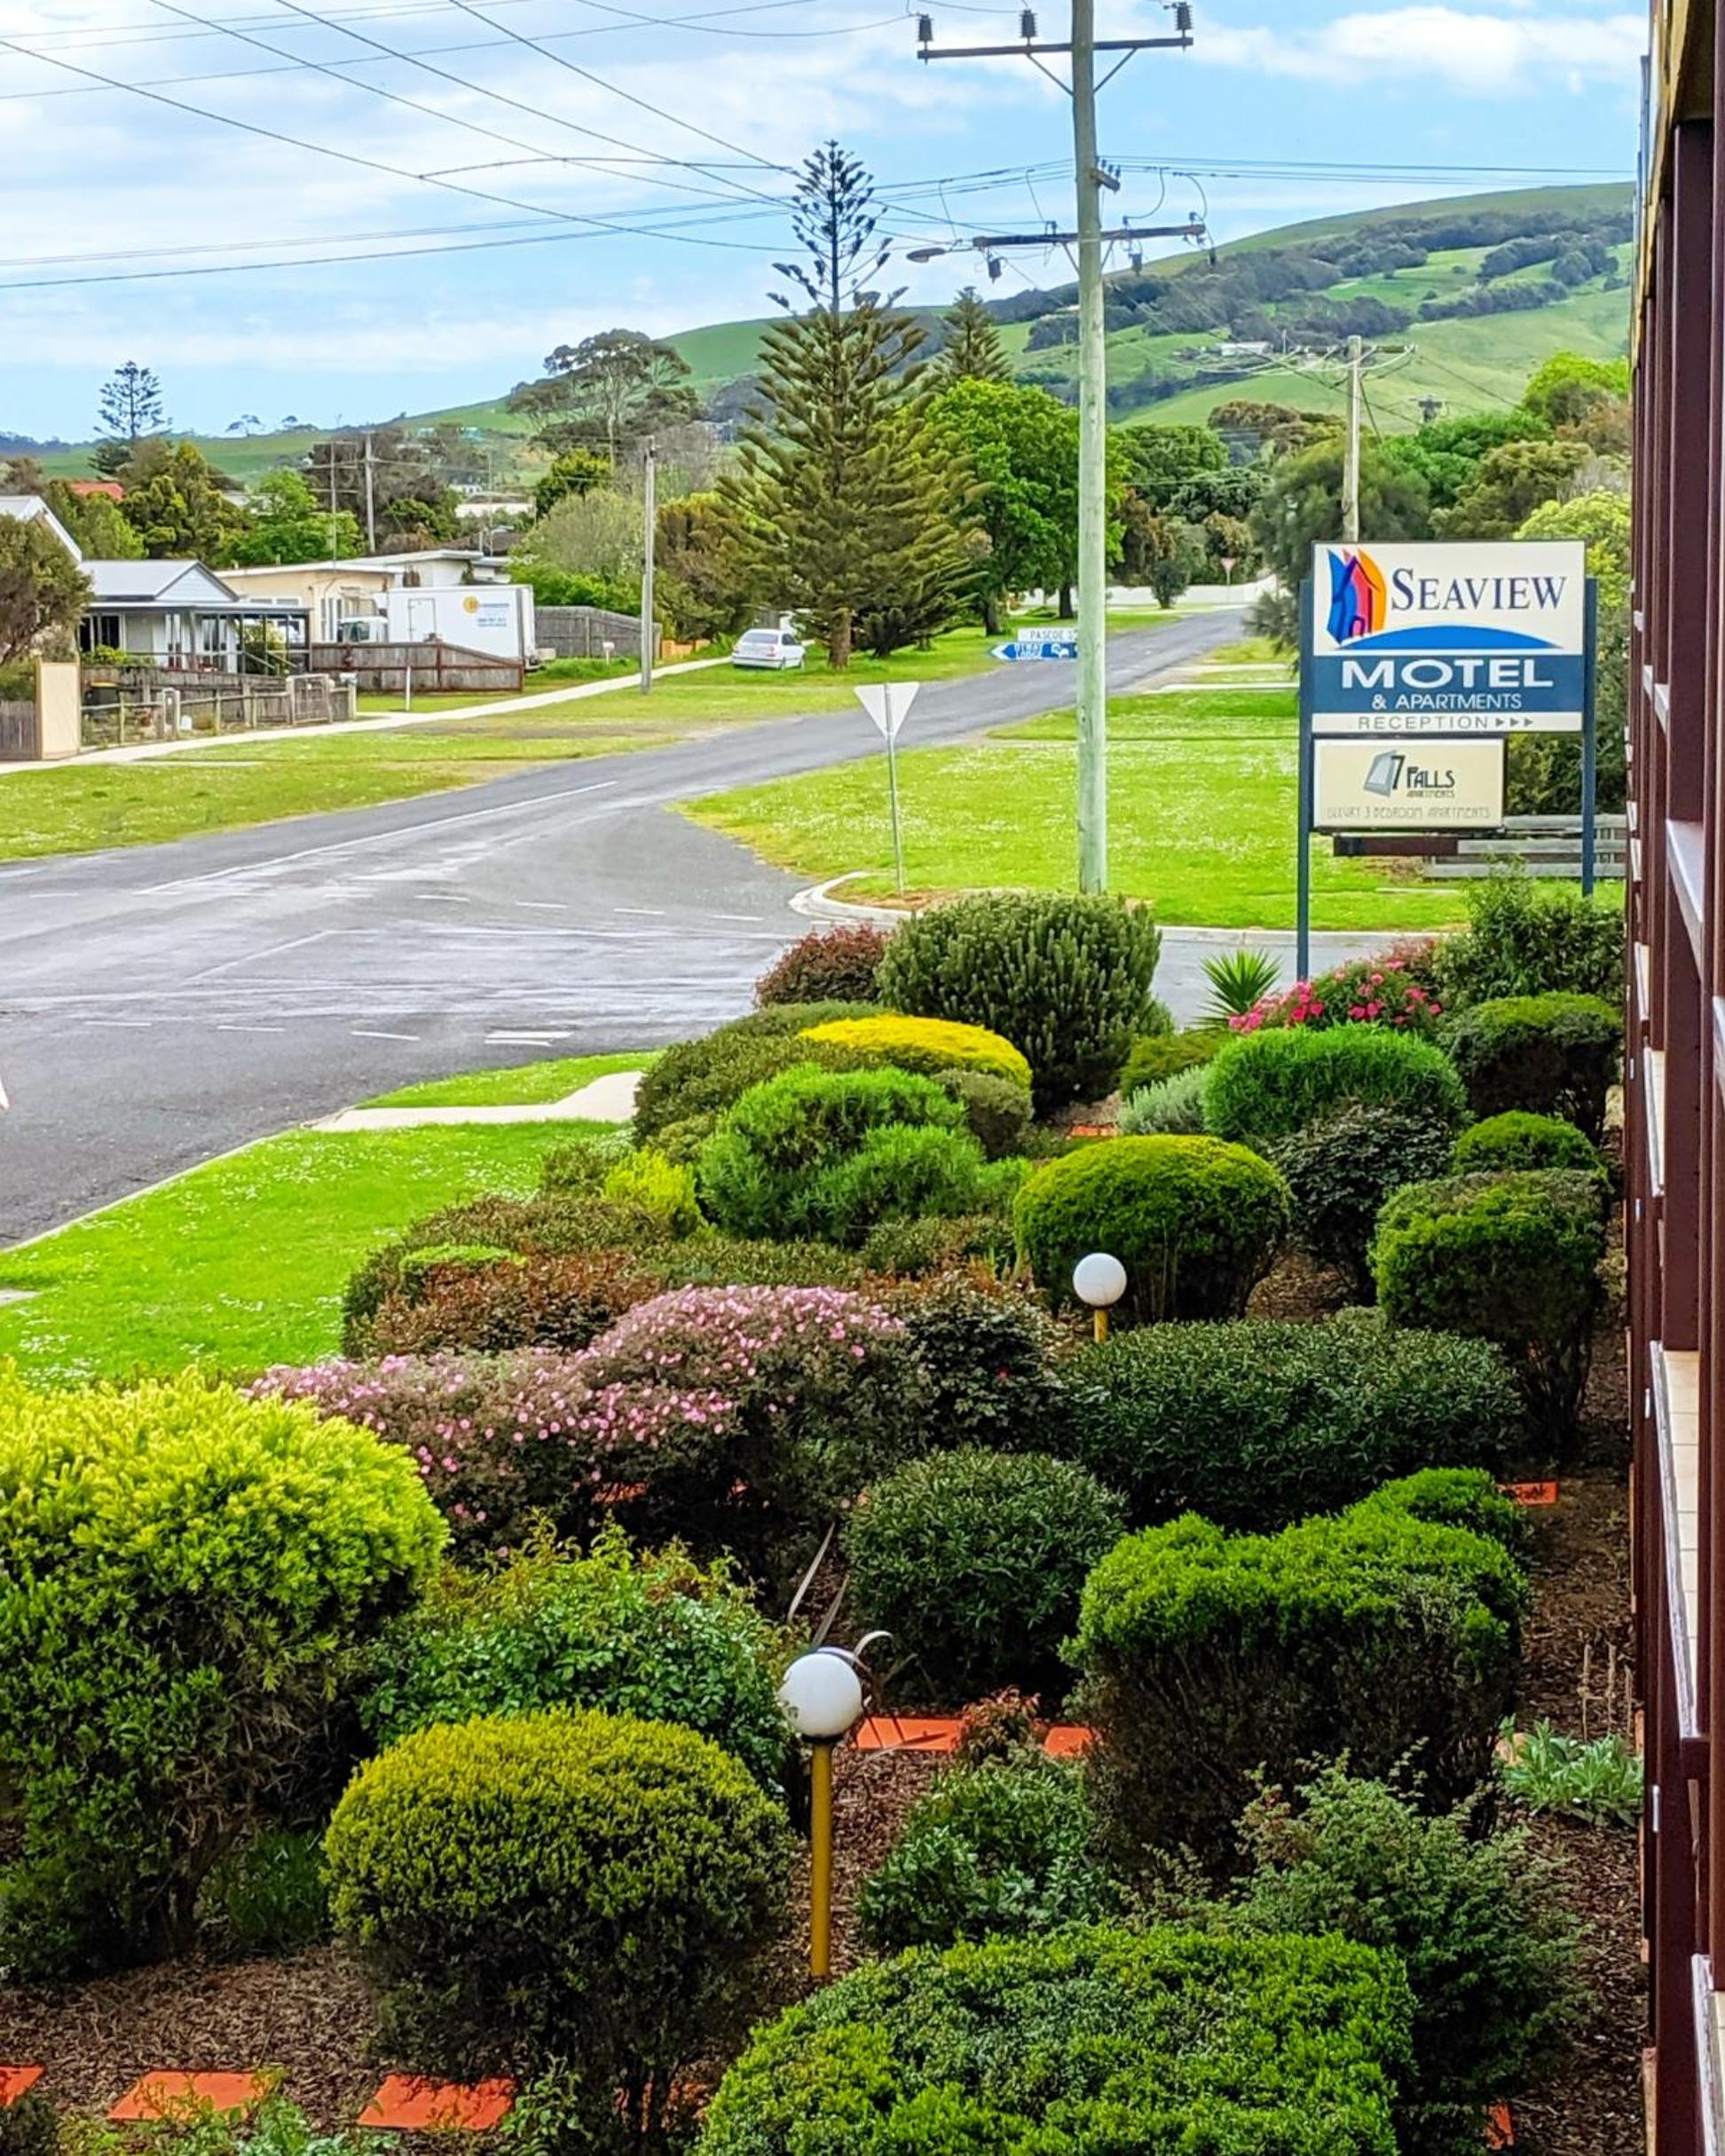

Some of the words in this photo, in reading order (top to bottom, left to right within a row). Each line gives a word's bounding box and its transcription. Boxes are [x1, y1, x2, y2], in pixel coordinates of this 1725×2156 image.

[1390, 568, 1567, 611] SEAVIEW
[1342, 658, 1554, 689] MOTEL
[1372, 694, 1388, 711] &
[1395, 693, 1523, 711] APARTMENTS
[1358, 715, 1490, 730] RECEPTION
[1390, 755, 1406, 790] 7
[1406, 767, 1455, 789] FALLS
[1427, 806, 1491, 819] APARTMENTS
